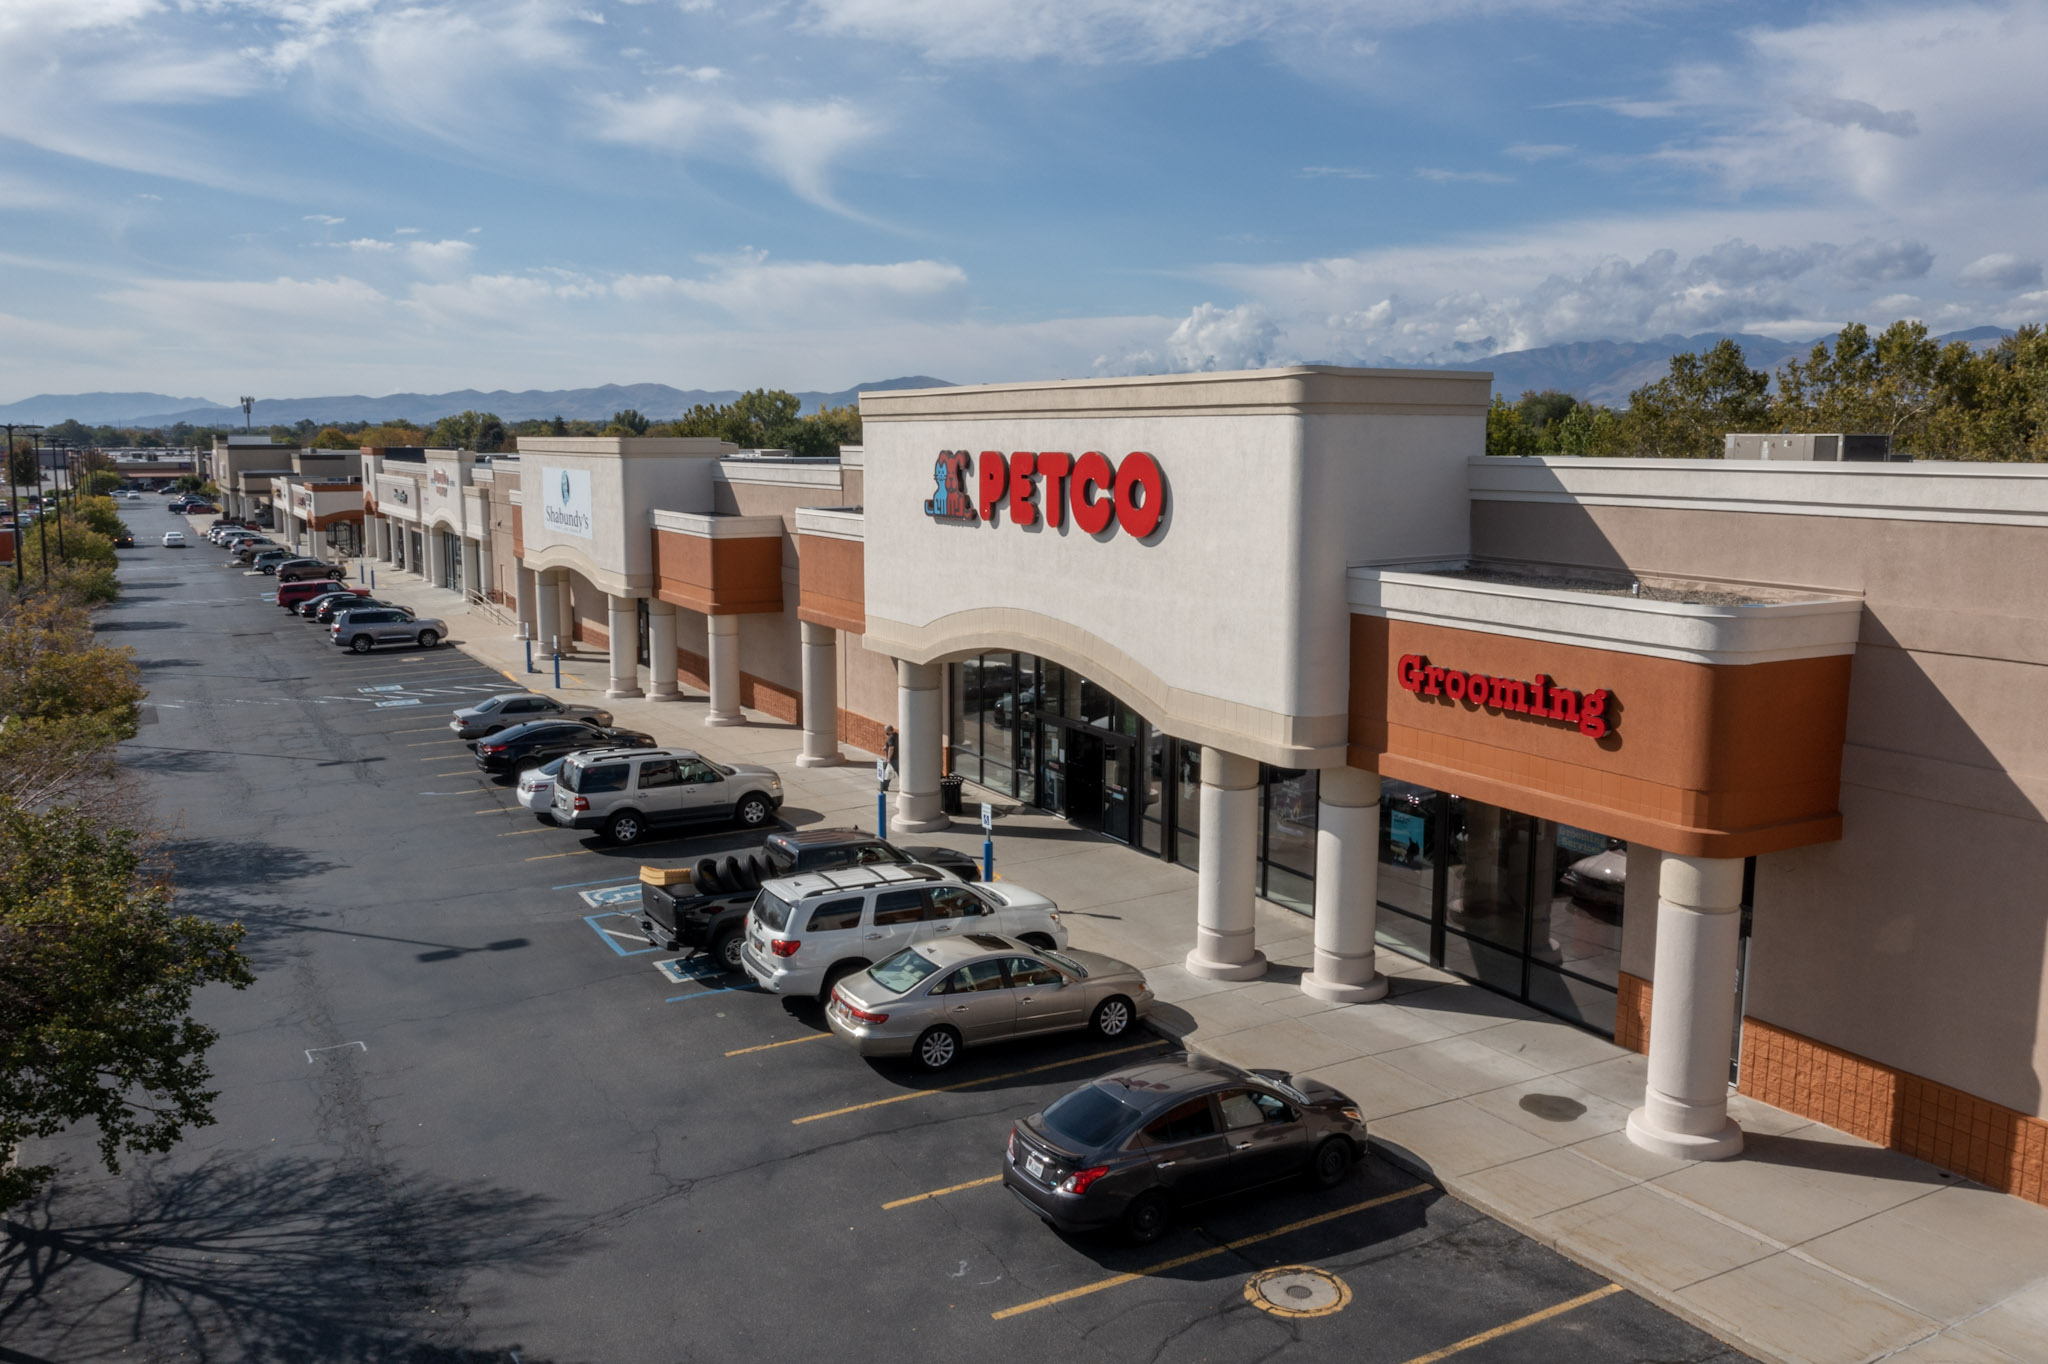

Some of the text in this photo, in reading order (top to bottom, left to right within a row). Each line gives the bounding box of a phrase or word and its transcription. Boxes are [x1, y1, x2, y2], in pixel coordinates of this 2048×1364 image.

[546, 505, 589, 533] Shabundy's
[979, 451, 1164, 538] PETCO
[1398, 654, 1608, 739] Grooming
